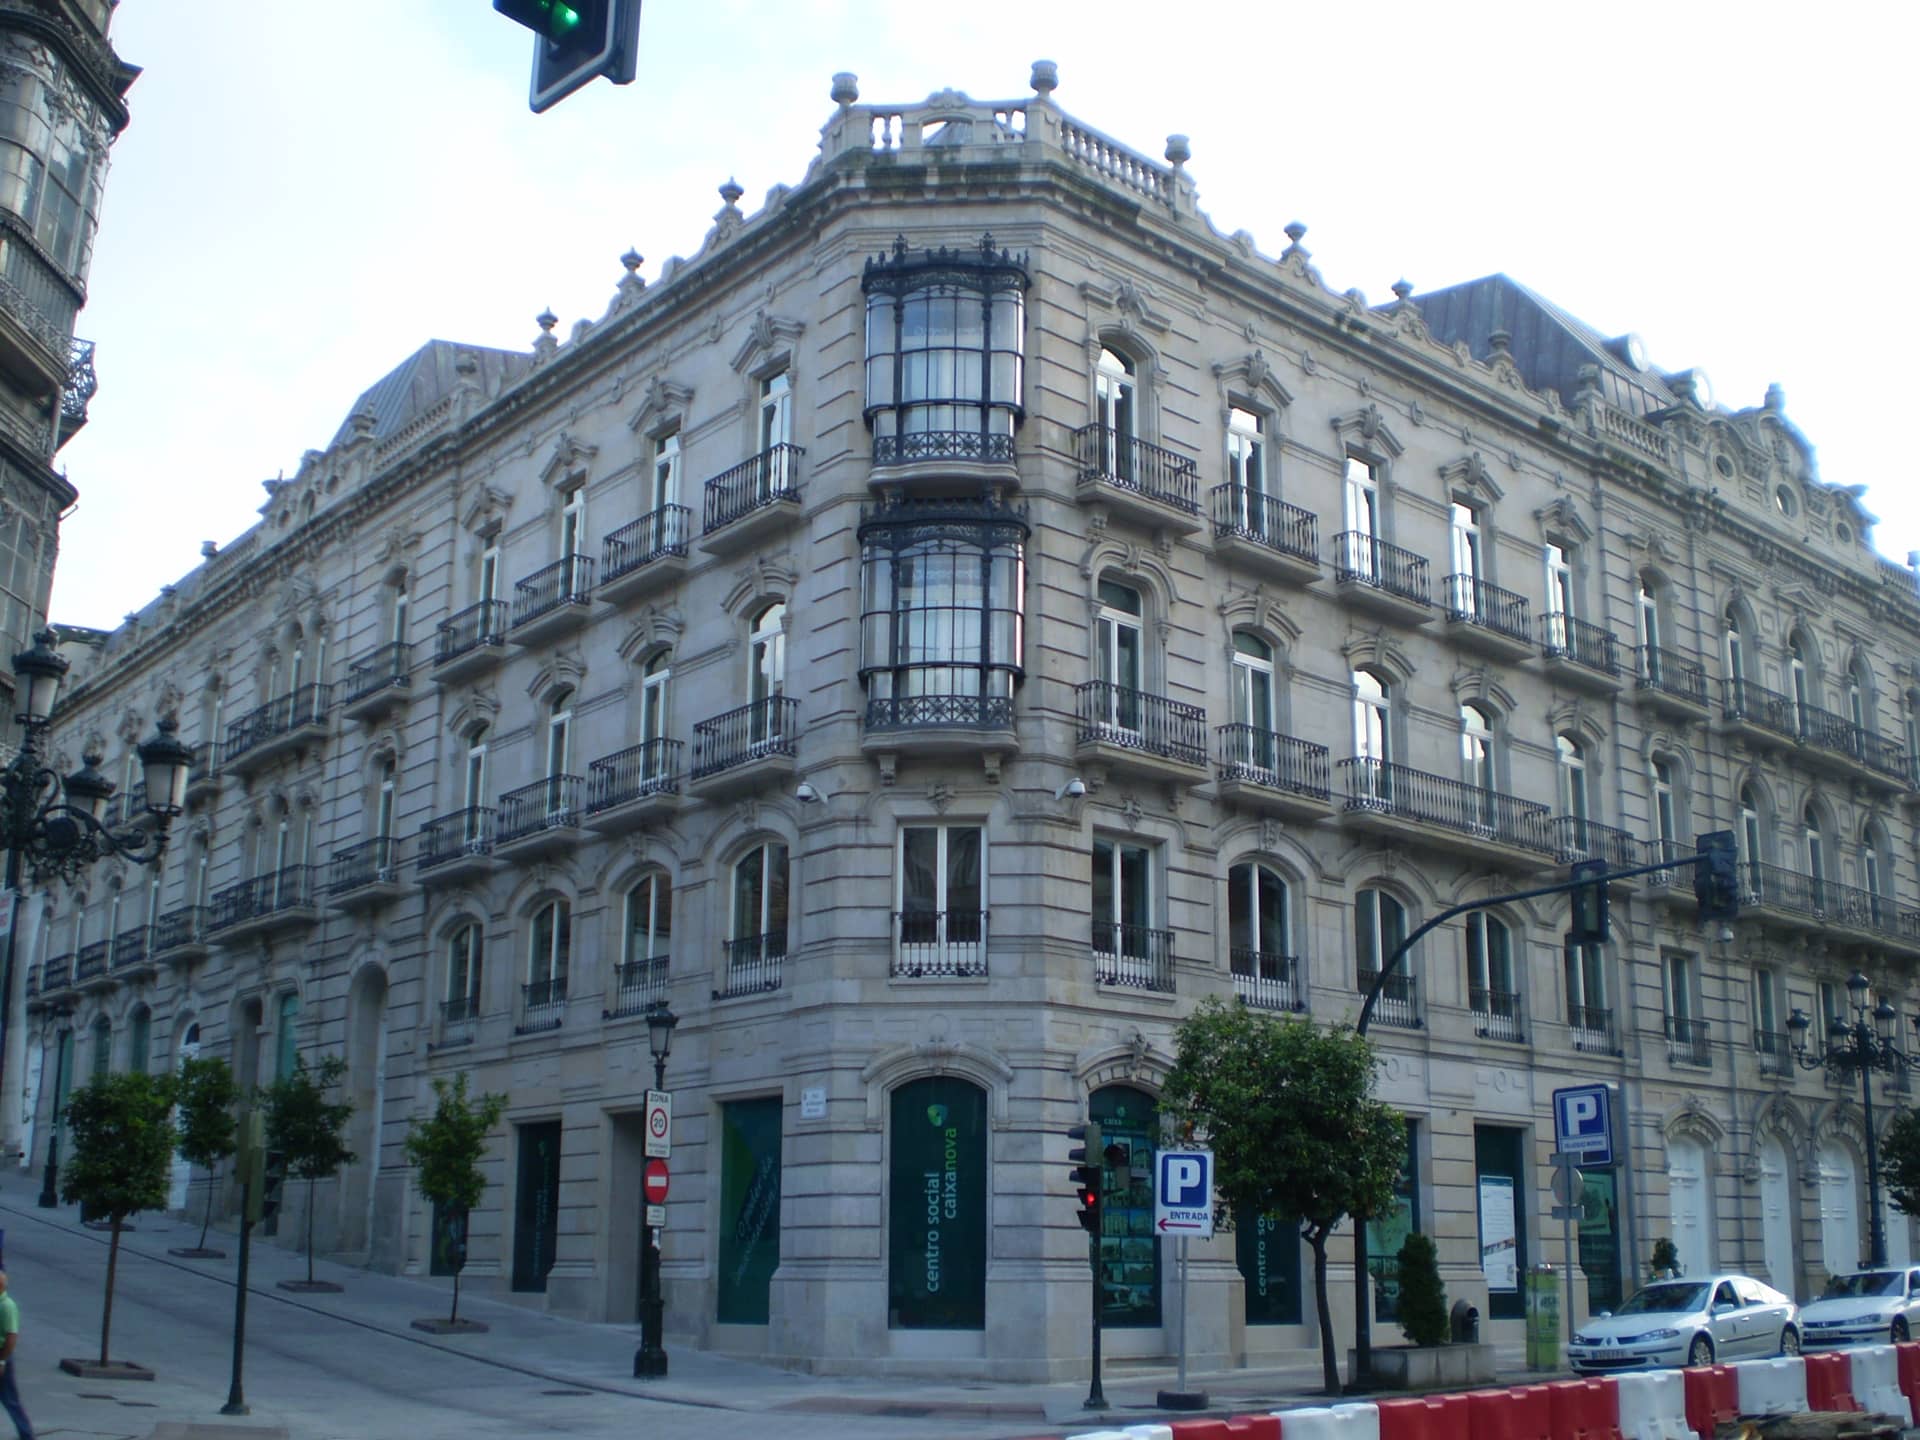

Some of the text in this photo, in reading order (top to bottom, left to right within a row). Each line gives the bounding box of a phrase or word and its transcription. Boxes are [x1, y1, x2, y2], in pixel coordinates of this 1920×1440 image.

[650, 1093, 669, 1103] ZONA
[1567, 1096, 1598, 1136] P
[653, 1117, 664, 1128] 20
[941, 1127, 958, 1219] caixanova
[1167, 1159, 1200, 1203] P
[924, 1171, 940, 1292] centro social
[1170, 1211, 1208, 1220] ENTRADA
[1257, 1240, 1267, 1297] centro
